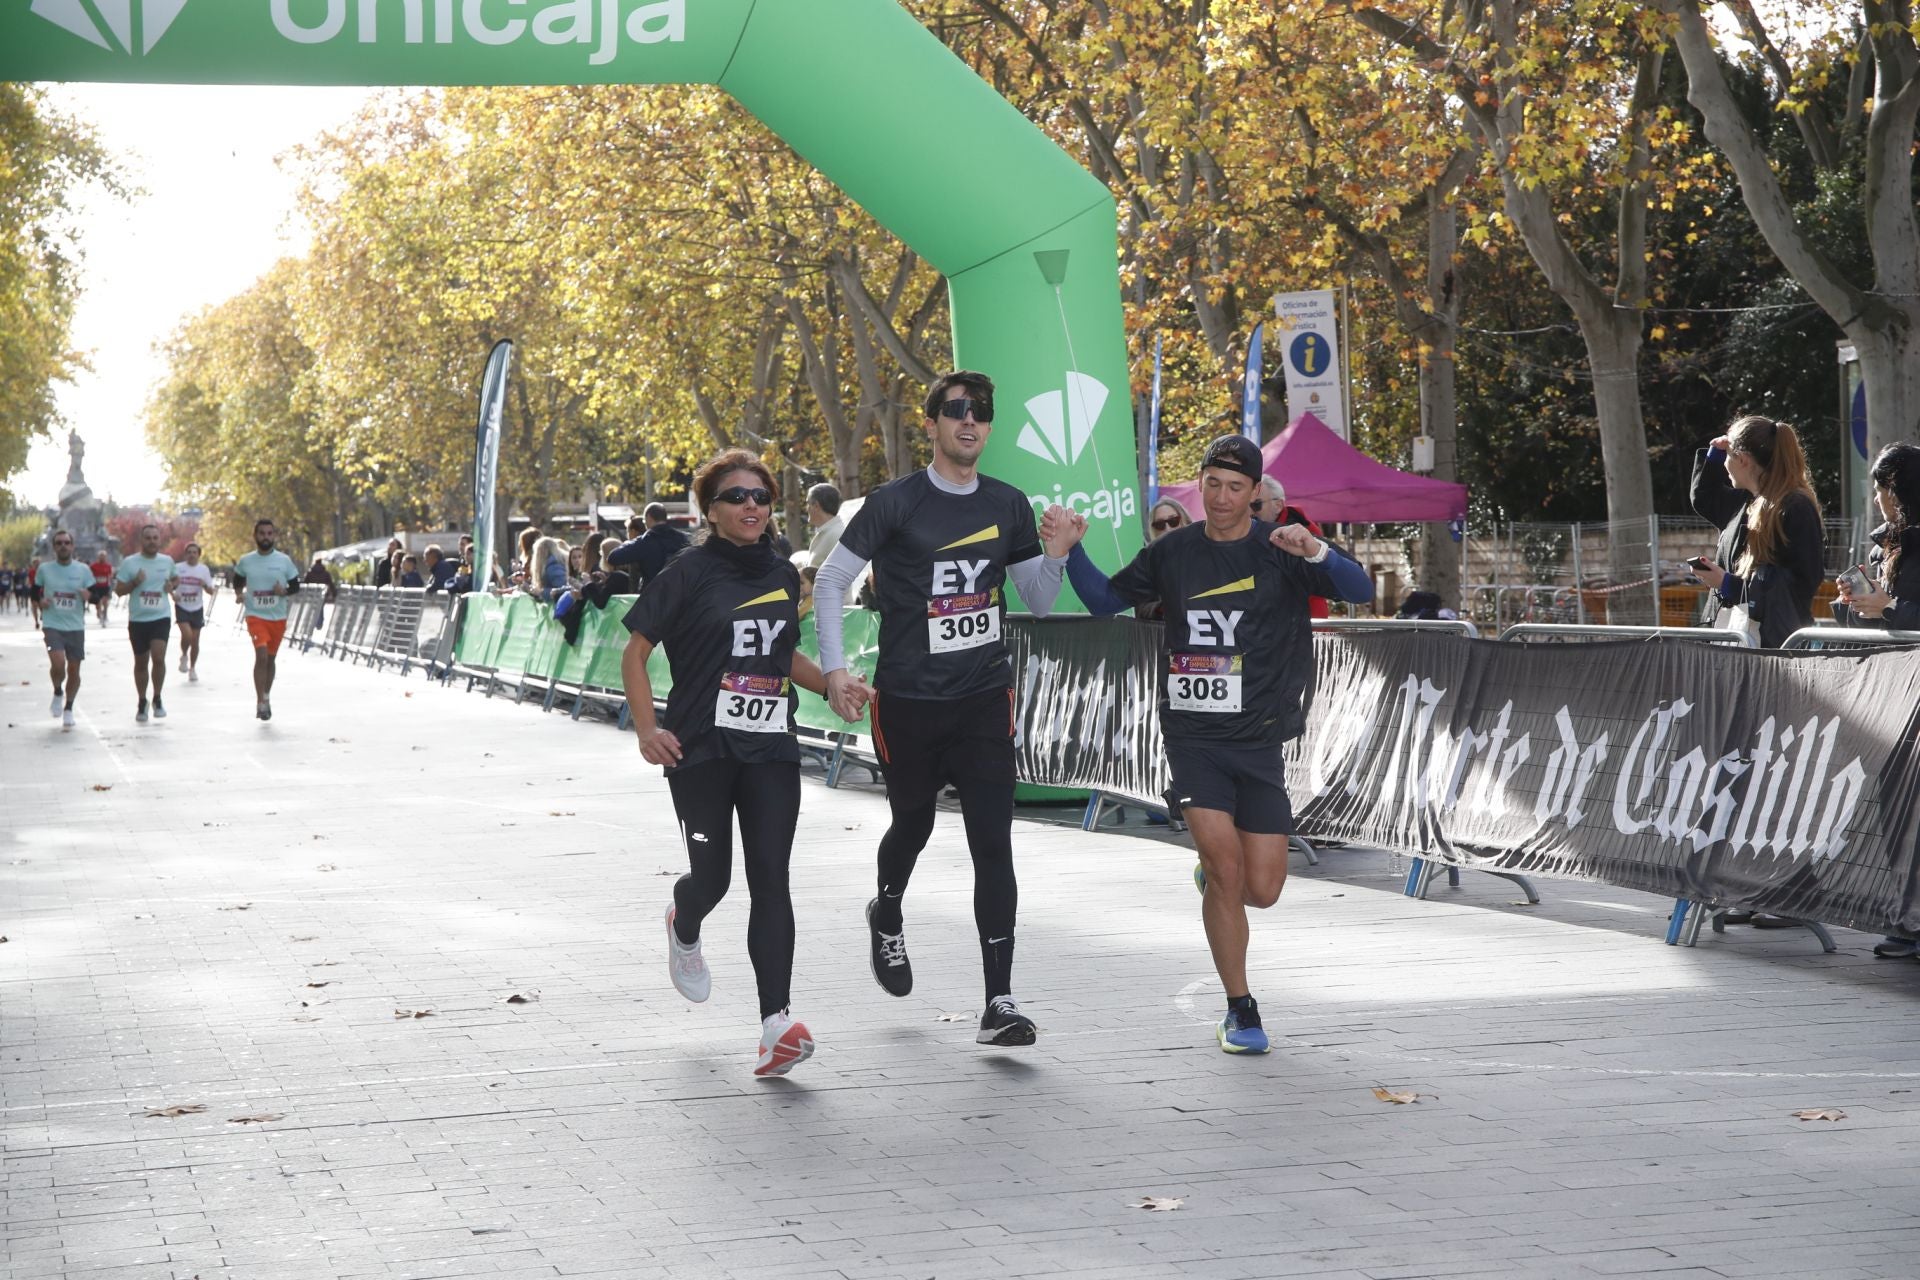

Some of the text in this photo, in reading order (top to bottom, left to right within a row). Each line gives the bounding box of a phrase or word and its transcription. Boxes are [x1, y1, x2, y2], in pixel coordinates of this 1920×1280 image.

[1282, 301, 1308, 310] Oficina
[1018, 479, 1135, 529] nicaja
[932, 559, 990, 596] EY
[143, 597, 160, 606] 787
[257, 597, 275, 606] 786
[953, 599, 980, 608] EMPRESAS
[731, 619, 787, 657] EY
[939, 613, 990, 640] 309
[1187, 610, 1244, 646] EY
[1177, 677, 1229, 701] 308
[726, 695, 779, 722] 307
[1379, 672, 1531, 822] Norte
[1531, 705, 1609, 830] de
[1612, 696, 1867, 864] Castilla
